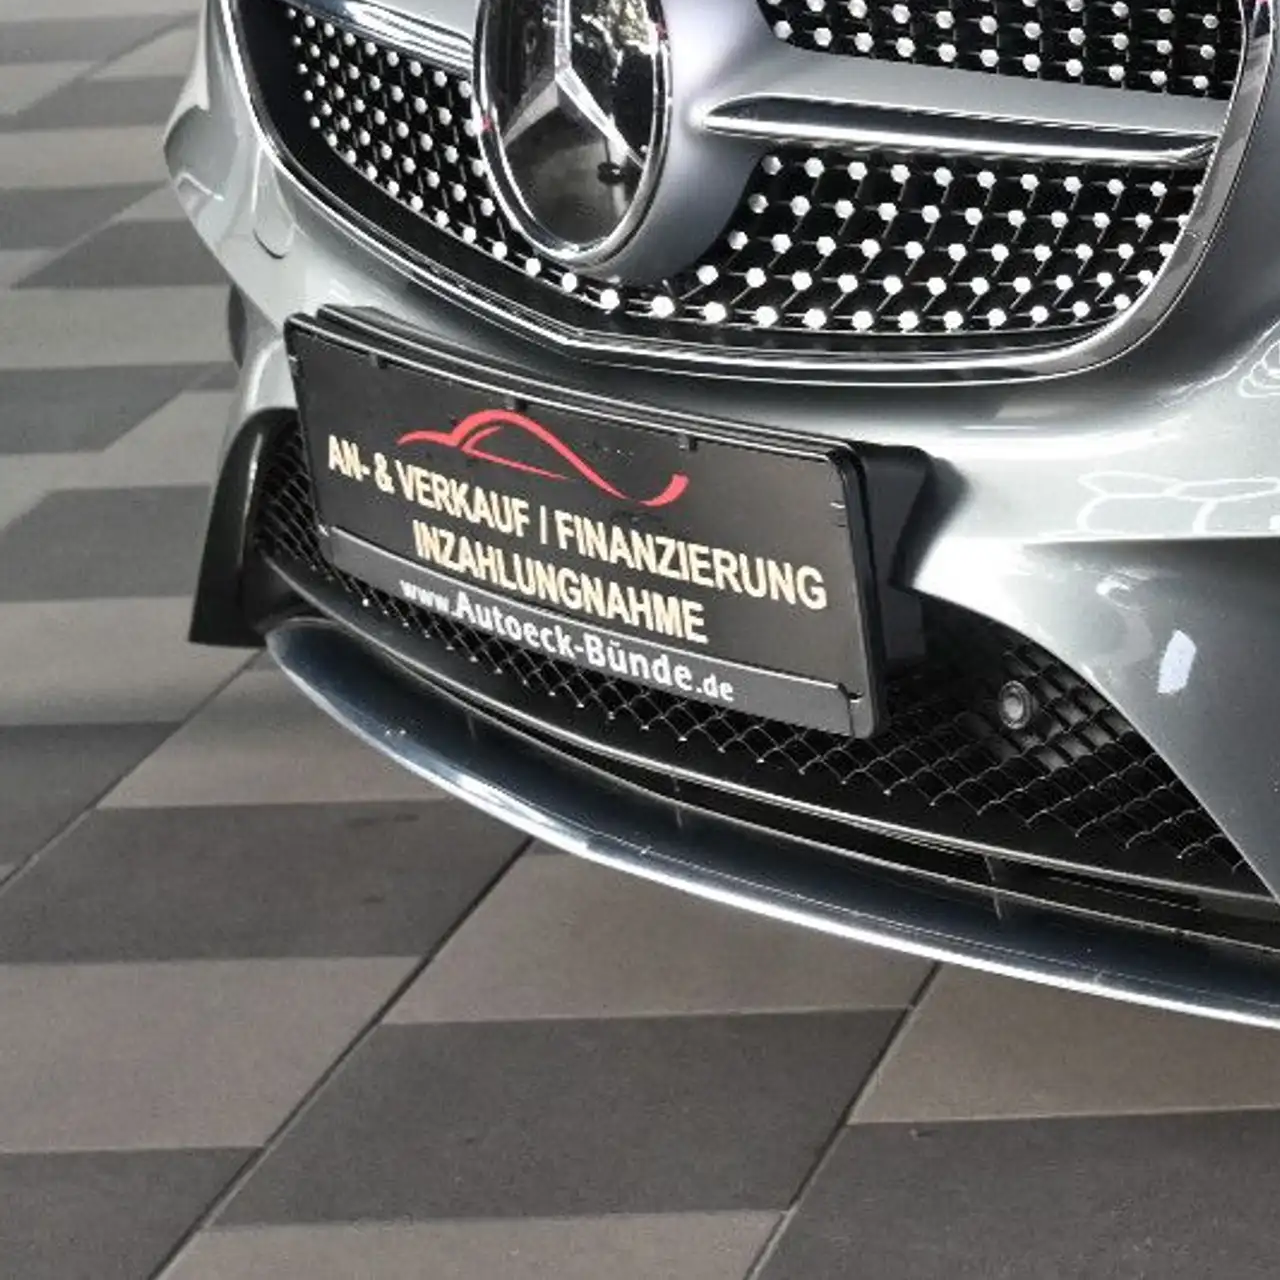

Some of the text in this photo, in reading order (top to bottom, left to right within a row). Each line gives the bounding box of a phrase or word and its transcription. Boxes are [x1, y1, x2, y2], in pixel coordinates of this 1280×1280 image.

[327, 433, 371, 482] AN-
[373, 452, 395, 494] &
[394, 458, 530, 538] VERKAUF
[554, 508, 828, 611] FINANZIERUNG
[412, 518, 709, 644] INZAHLUNGNAHME
[399, 579, 734, 703] www.Autoeck-Bünde.de
